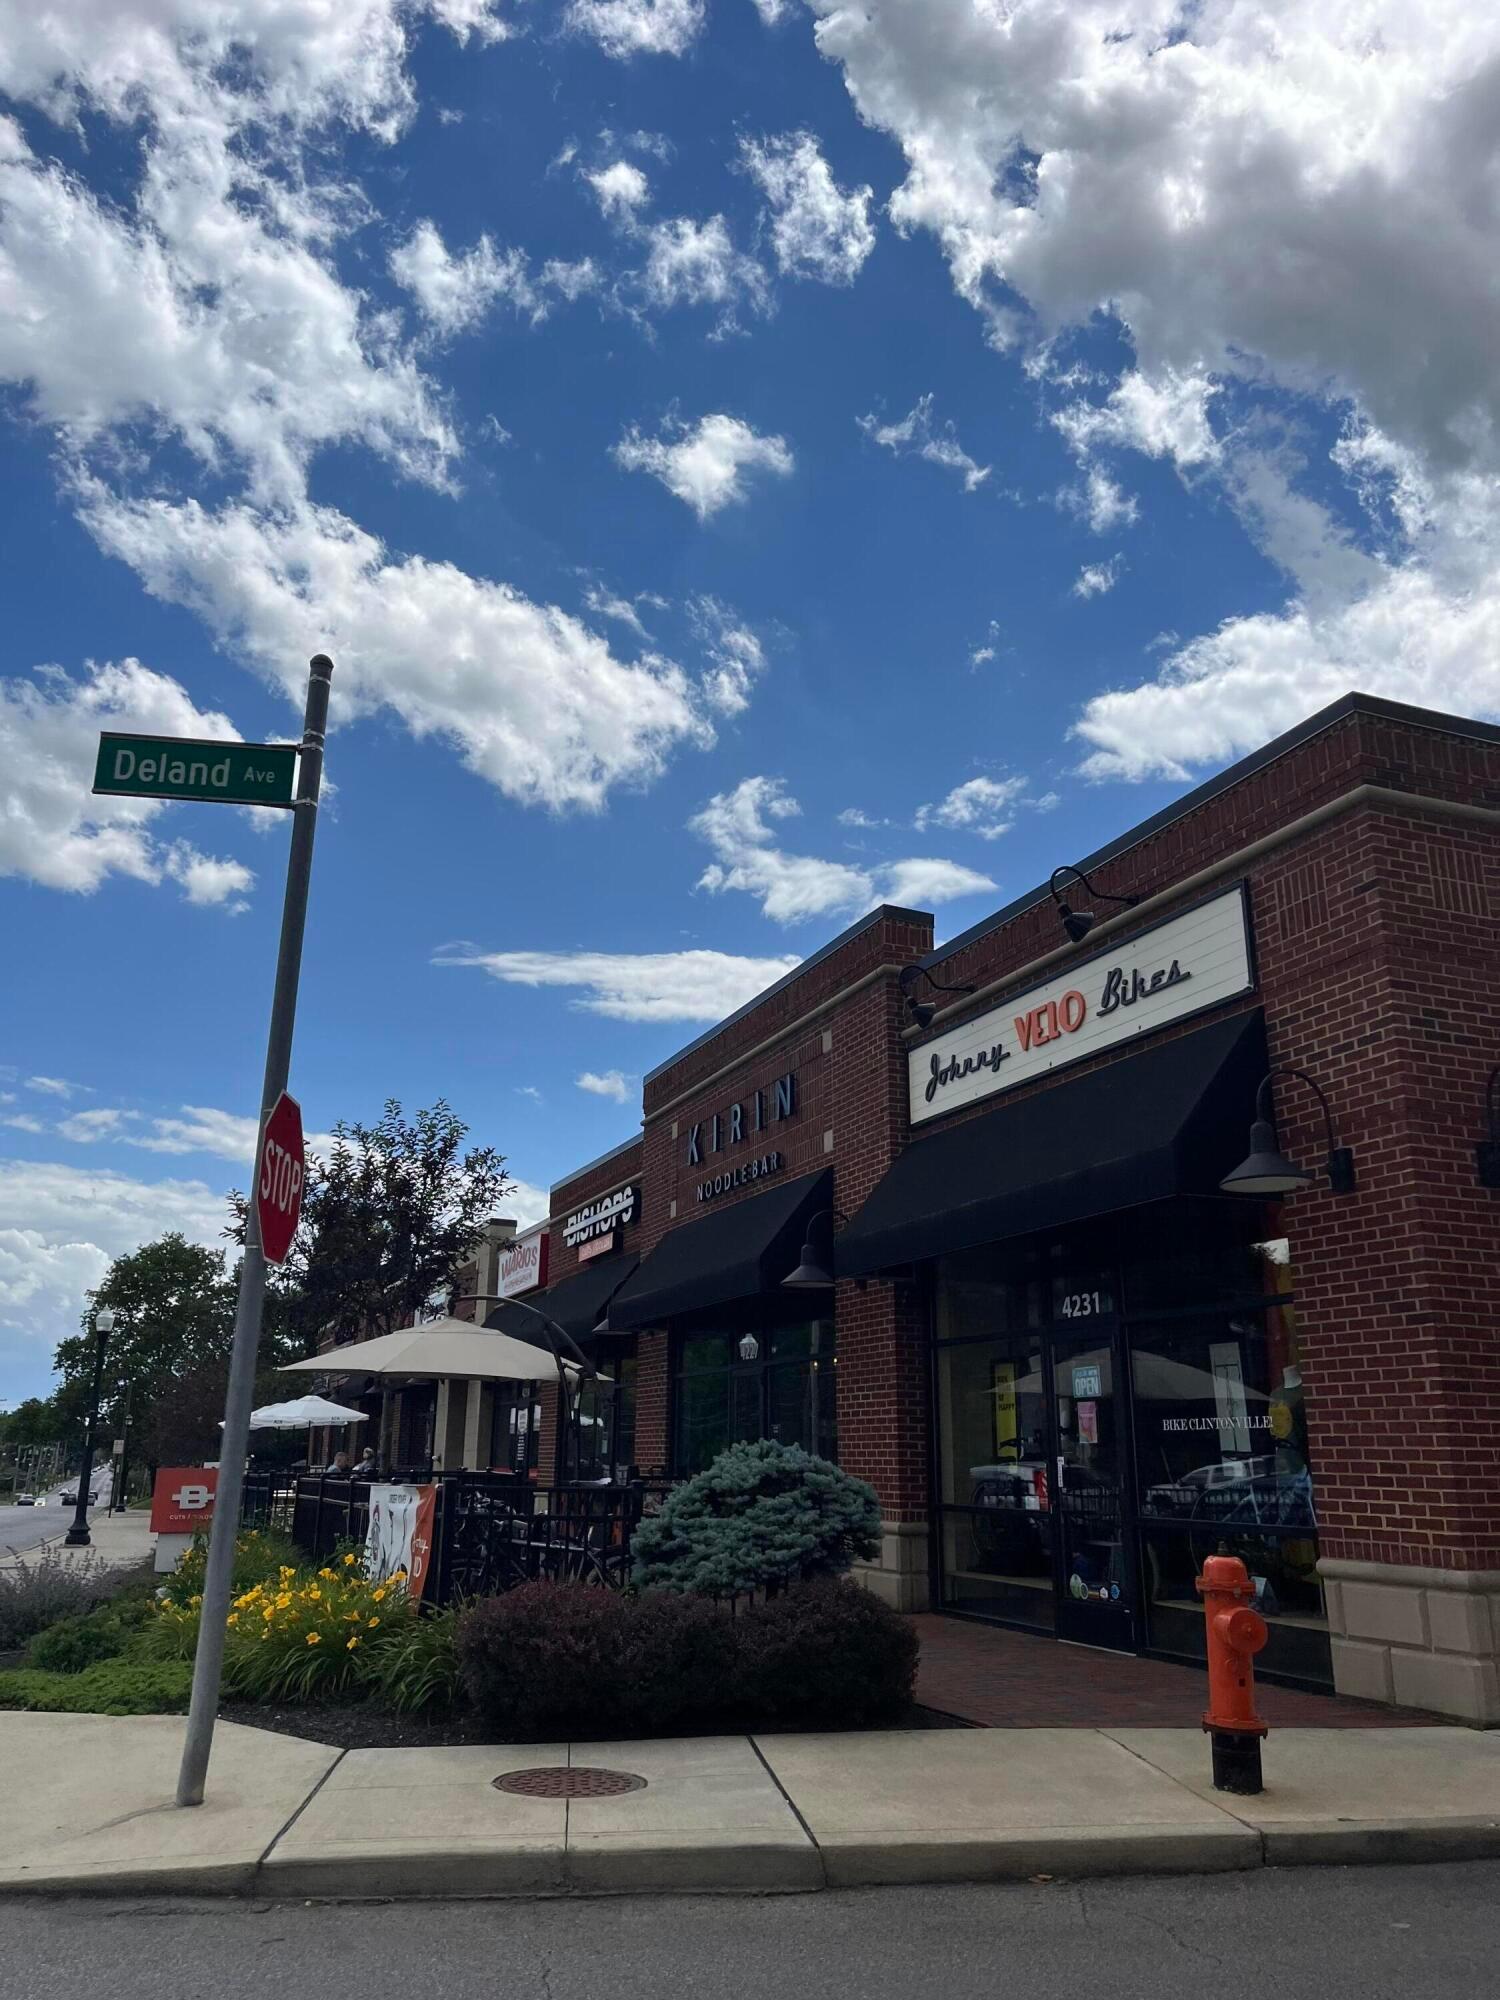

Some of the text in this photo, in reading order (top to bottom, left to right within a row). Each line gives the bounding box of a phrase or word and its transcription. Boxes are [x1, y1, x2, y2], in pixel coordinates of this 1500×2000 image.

[113, 749, 276, 787] Deland Ave
[925, 959, 1191, 1102] Johnny VELO Bikes
[688, 1073, 792, 1167] KIRIN
[261, 1138, 300, 1215] STOP
[564, 1186, 634, 1248] BISHOPS
[1062, 1291, 1100, 1318] 4231
[1075, 1376, 1099, 1396] OPEN
[1162, 1415, 1274, 1431] BIKE CLINTONVILLE!
